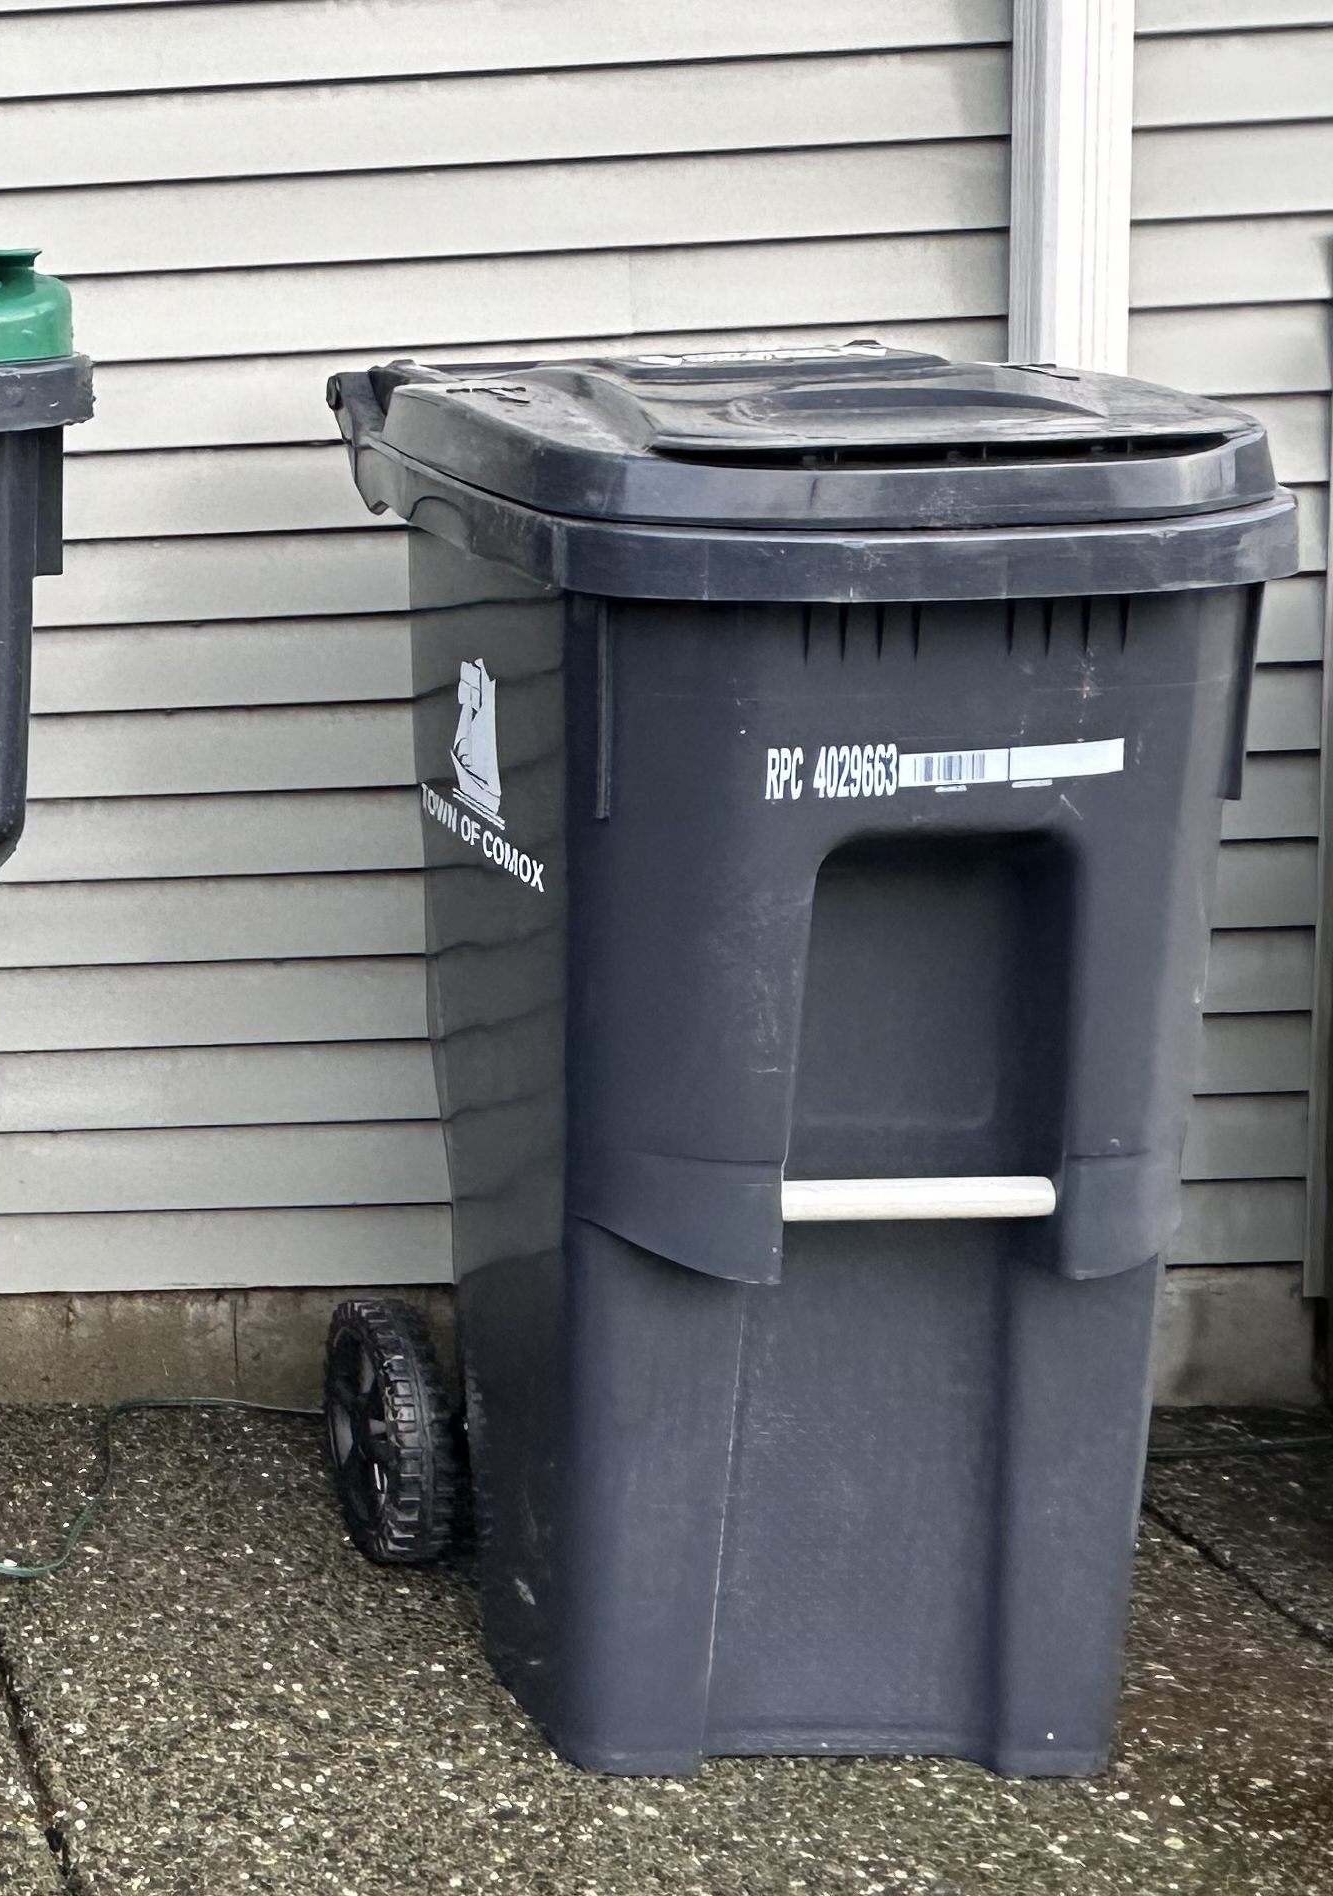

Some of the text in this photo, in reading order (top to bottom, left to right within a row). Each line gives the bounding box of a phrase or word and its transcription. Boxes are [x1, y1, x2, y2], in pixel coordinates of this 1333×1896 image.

[764, 743, 898, 801] RPC 4029663
[420, 782, 545, 893] TOWN OF COMOX
